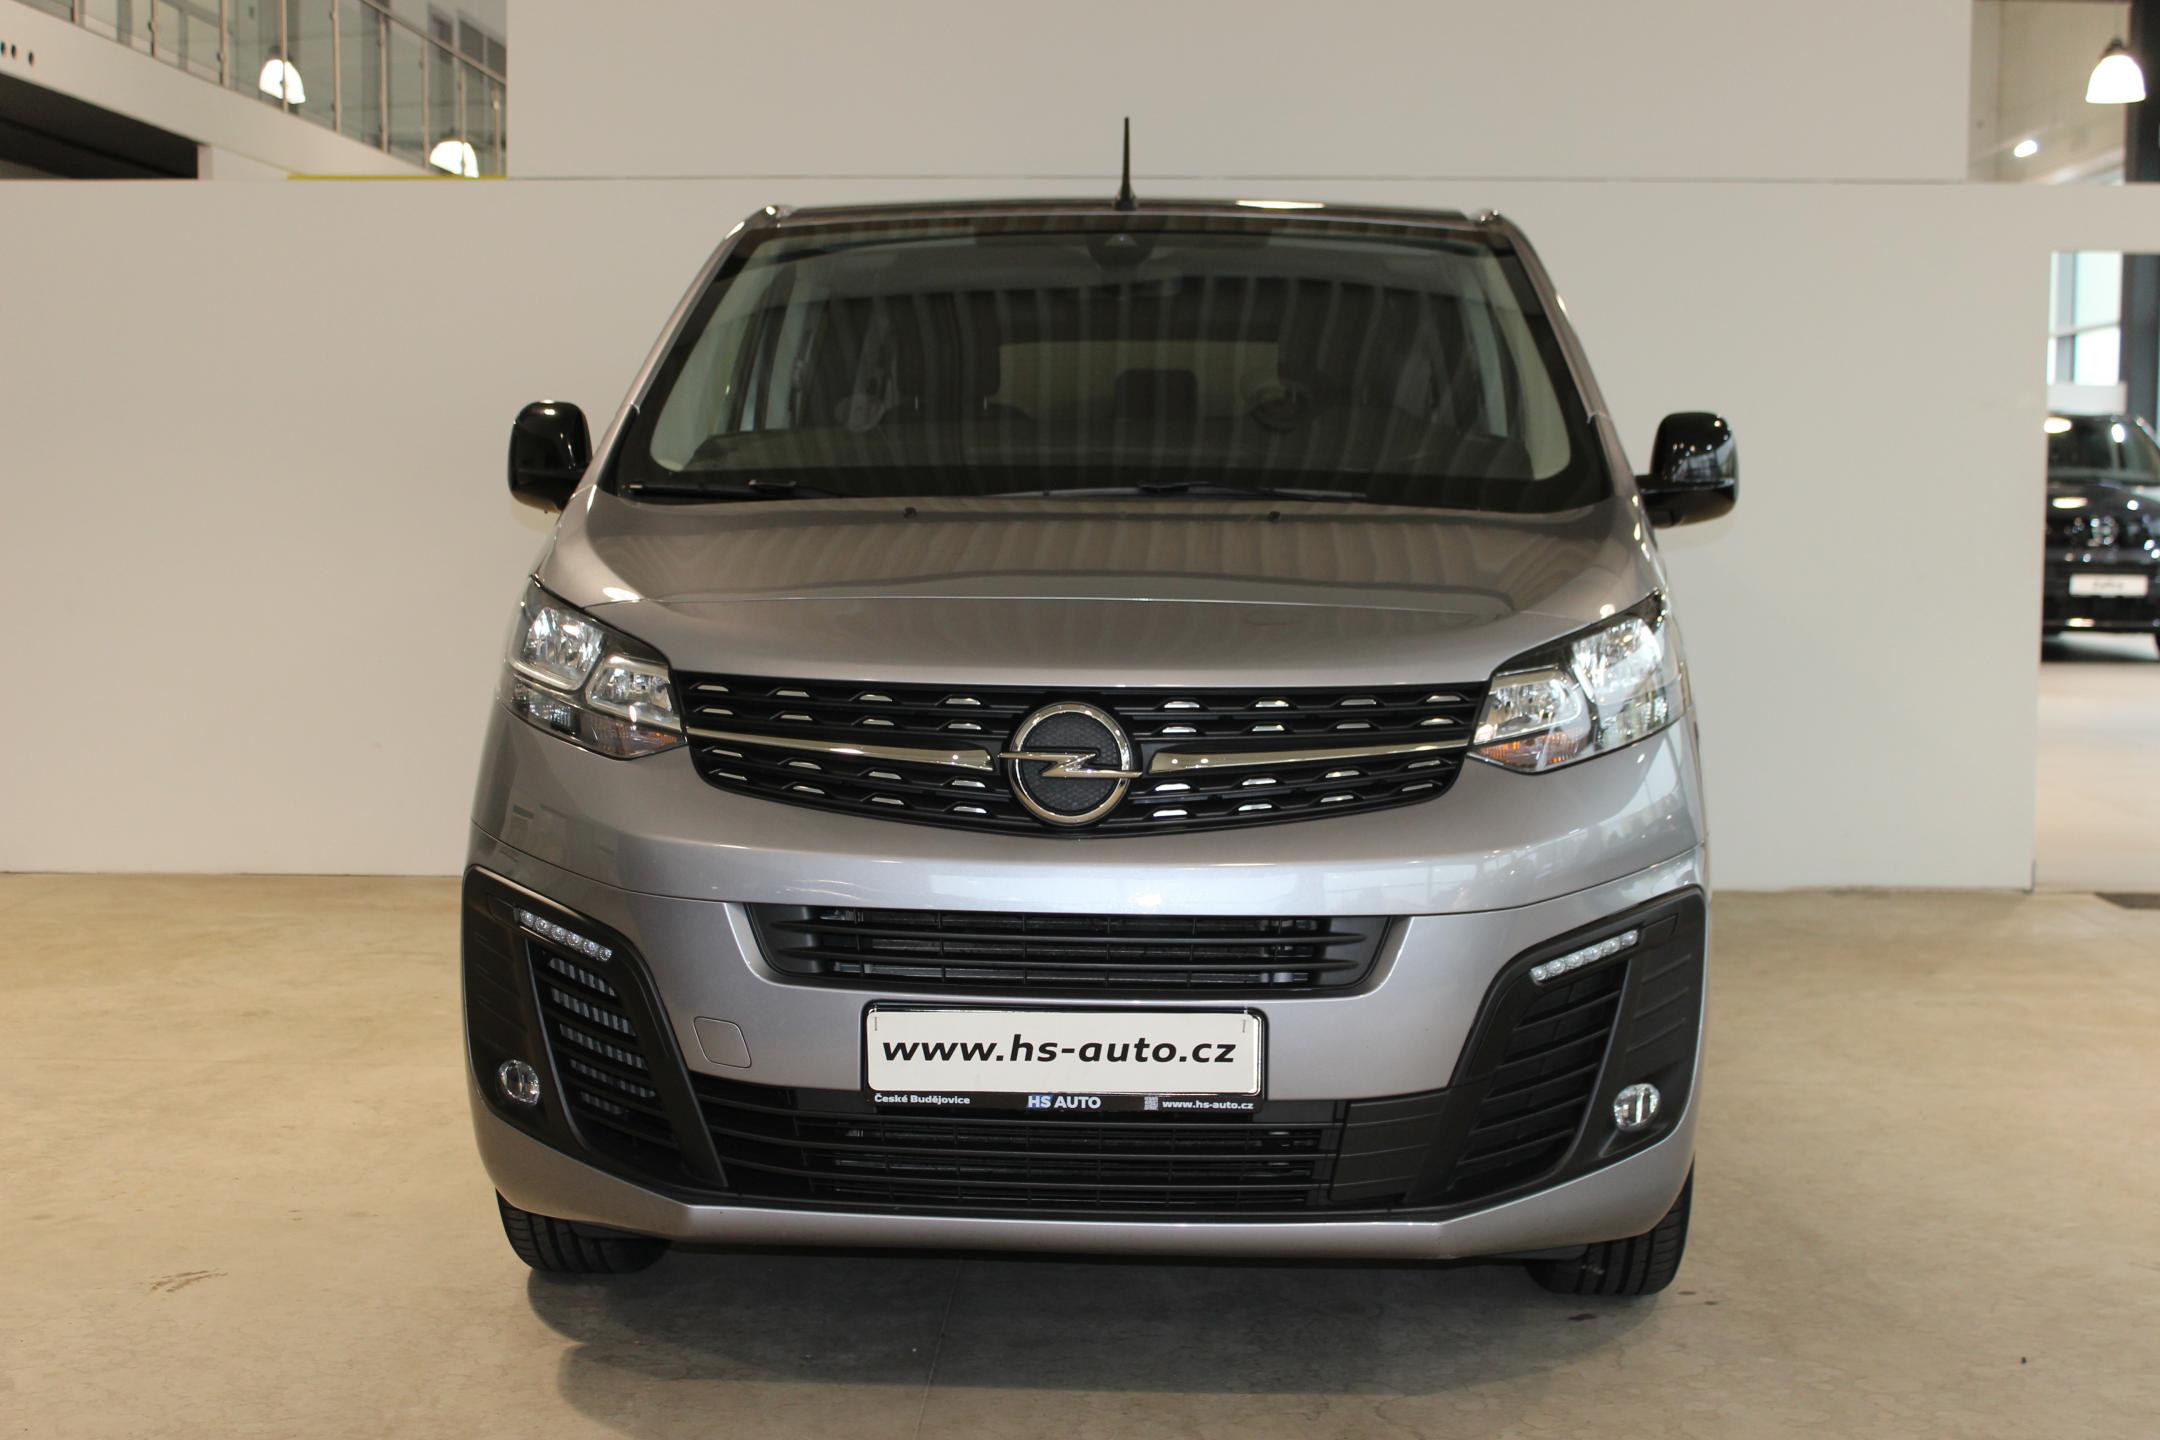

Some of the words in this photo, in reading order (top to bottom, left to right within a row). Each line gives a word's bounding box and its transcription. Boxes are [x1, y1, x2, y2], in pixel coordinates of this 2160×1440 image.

[882, 1034, 1237, 1063] www.hs-auto.cz
[874, 1093, 908, 1103] České
[910, 1095, 971, 1105] Budějovice
[1027, 1095, 1052, 1108] HS
[1053, 1096, 1102, 1109] AUTO
[1162, 1100, 1254, 1109] www.hs-auto.cz
